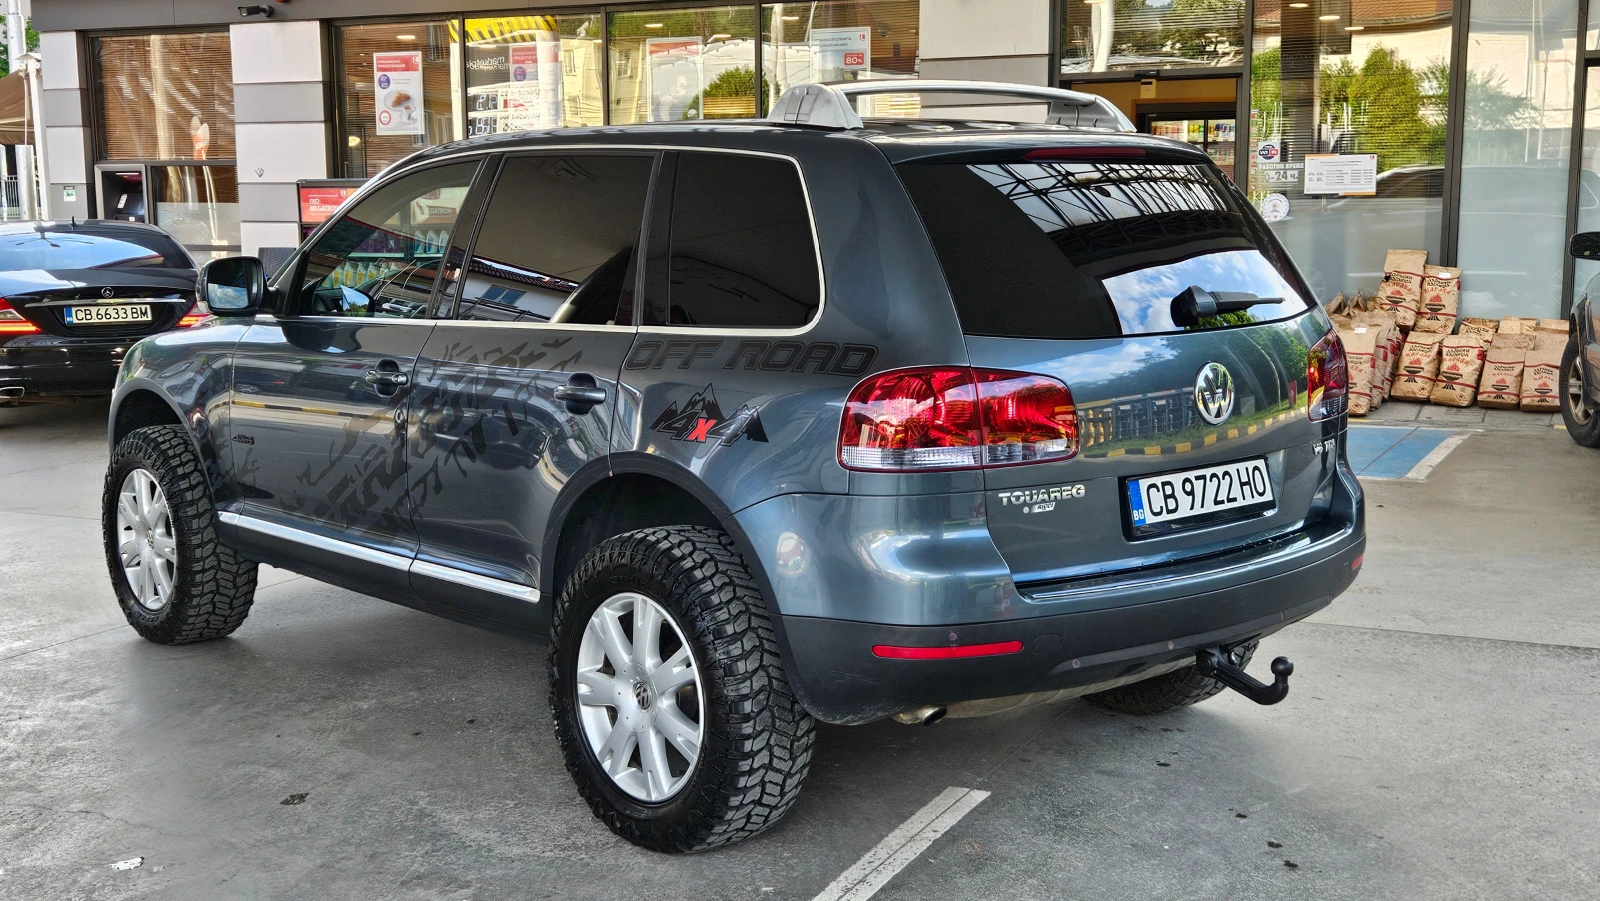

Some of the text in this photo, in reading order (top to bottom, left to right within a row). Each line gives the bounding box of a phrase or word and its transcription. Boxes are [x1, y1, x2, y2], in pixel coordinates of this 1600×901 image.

[95, 307, 129, 320] 6633
[130, 306, 149, 319] BM
[625, 339, 879, 377] OFF ROAD
[998, 484, 1086, 506] TOUAREG
[1146, 464, 1267, 517] CB 9722 HO
[1132, 509, 1145, 521] BG
